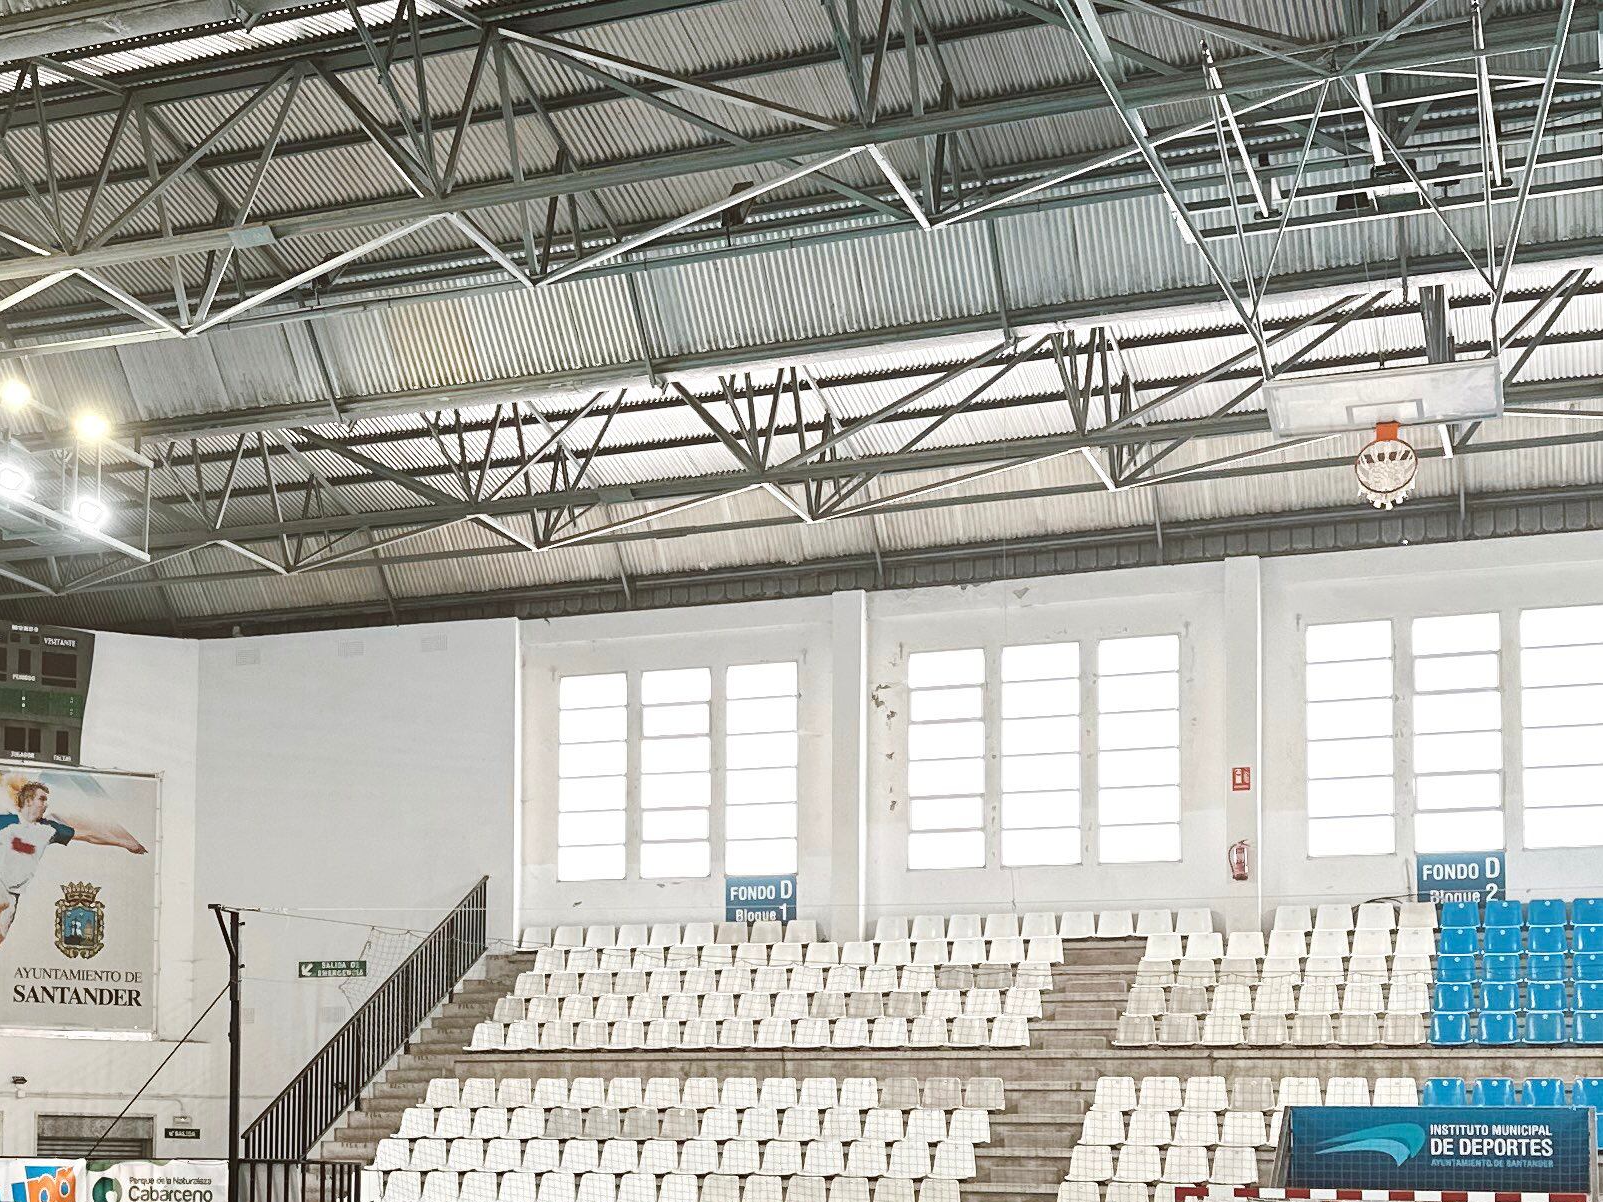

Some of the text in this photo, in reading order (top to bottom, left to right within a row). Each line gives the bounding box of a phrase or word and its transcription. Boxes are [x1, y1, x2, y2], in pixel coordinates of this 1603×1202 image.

[1422, 857, 1500, 881] FONDO D
[730, 879, 793, 901] FONDO D
[1429, 883, 1499, 904] Bloque 2
[735, 902, 787, 922] Bloque 1
[13, 966, 143, 984] AYUNTAMIENTO DE
[12, 984, 143, 1008] SANTANDER
[1430, 1123, 1553, 1137] INSTITUTO MUNICIPAL
[1430, 1138, 1553, 1157] DE DEPORTES
[1430, 1159, 1493, 1168] AYUNTAMIENTO
[1506, 1159, 1554, 1168] SANTANDER
[129, 1176, 154, 1186] Parque
[128, 1185, 213, 1202] Cabarceno
